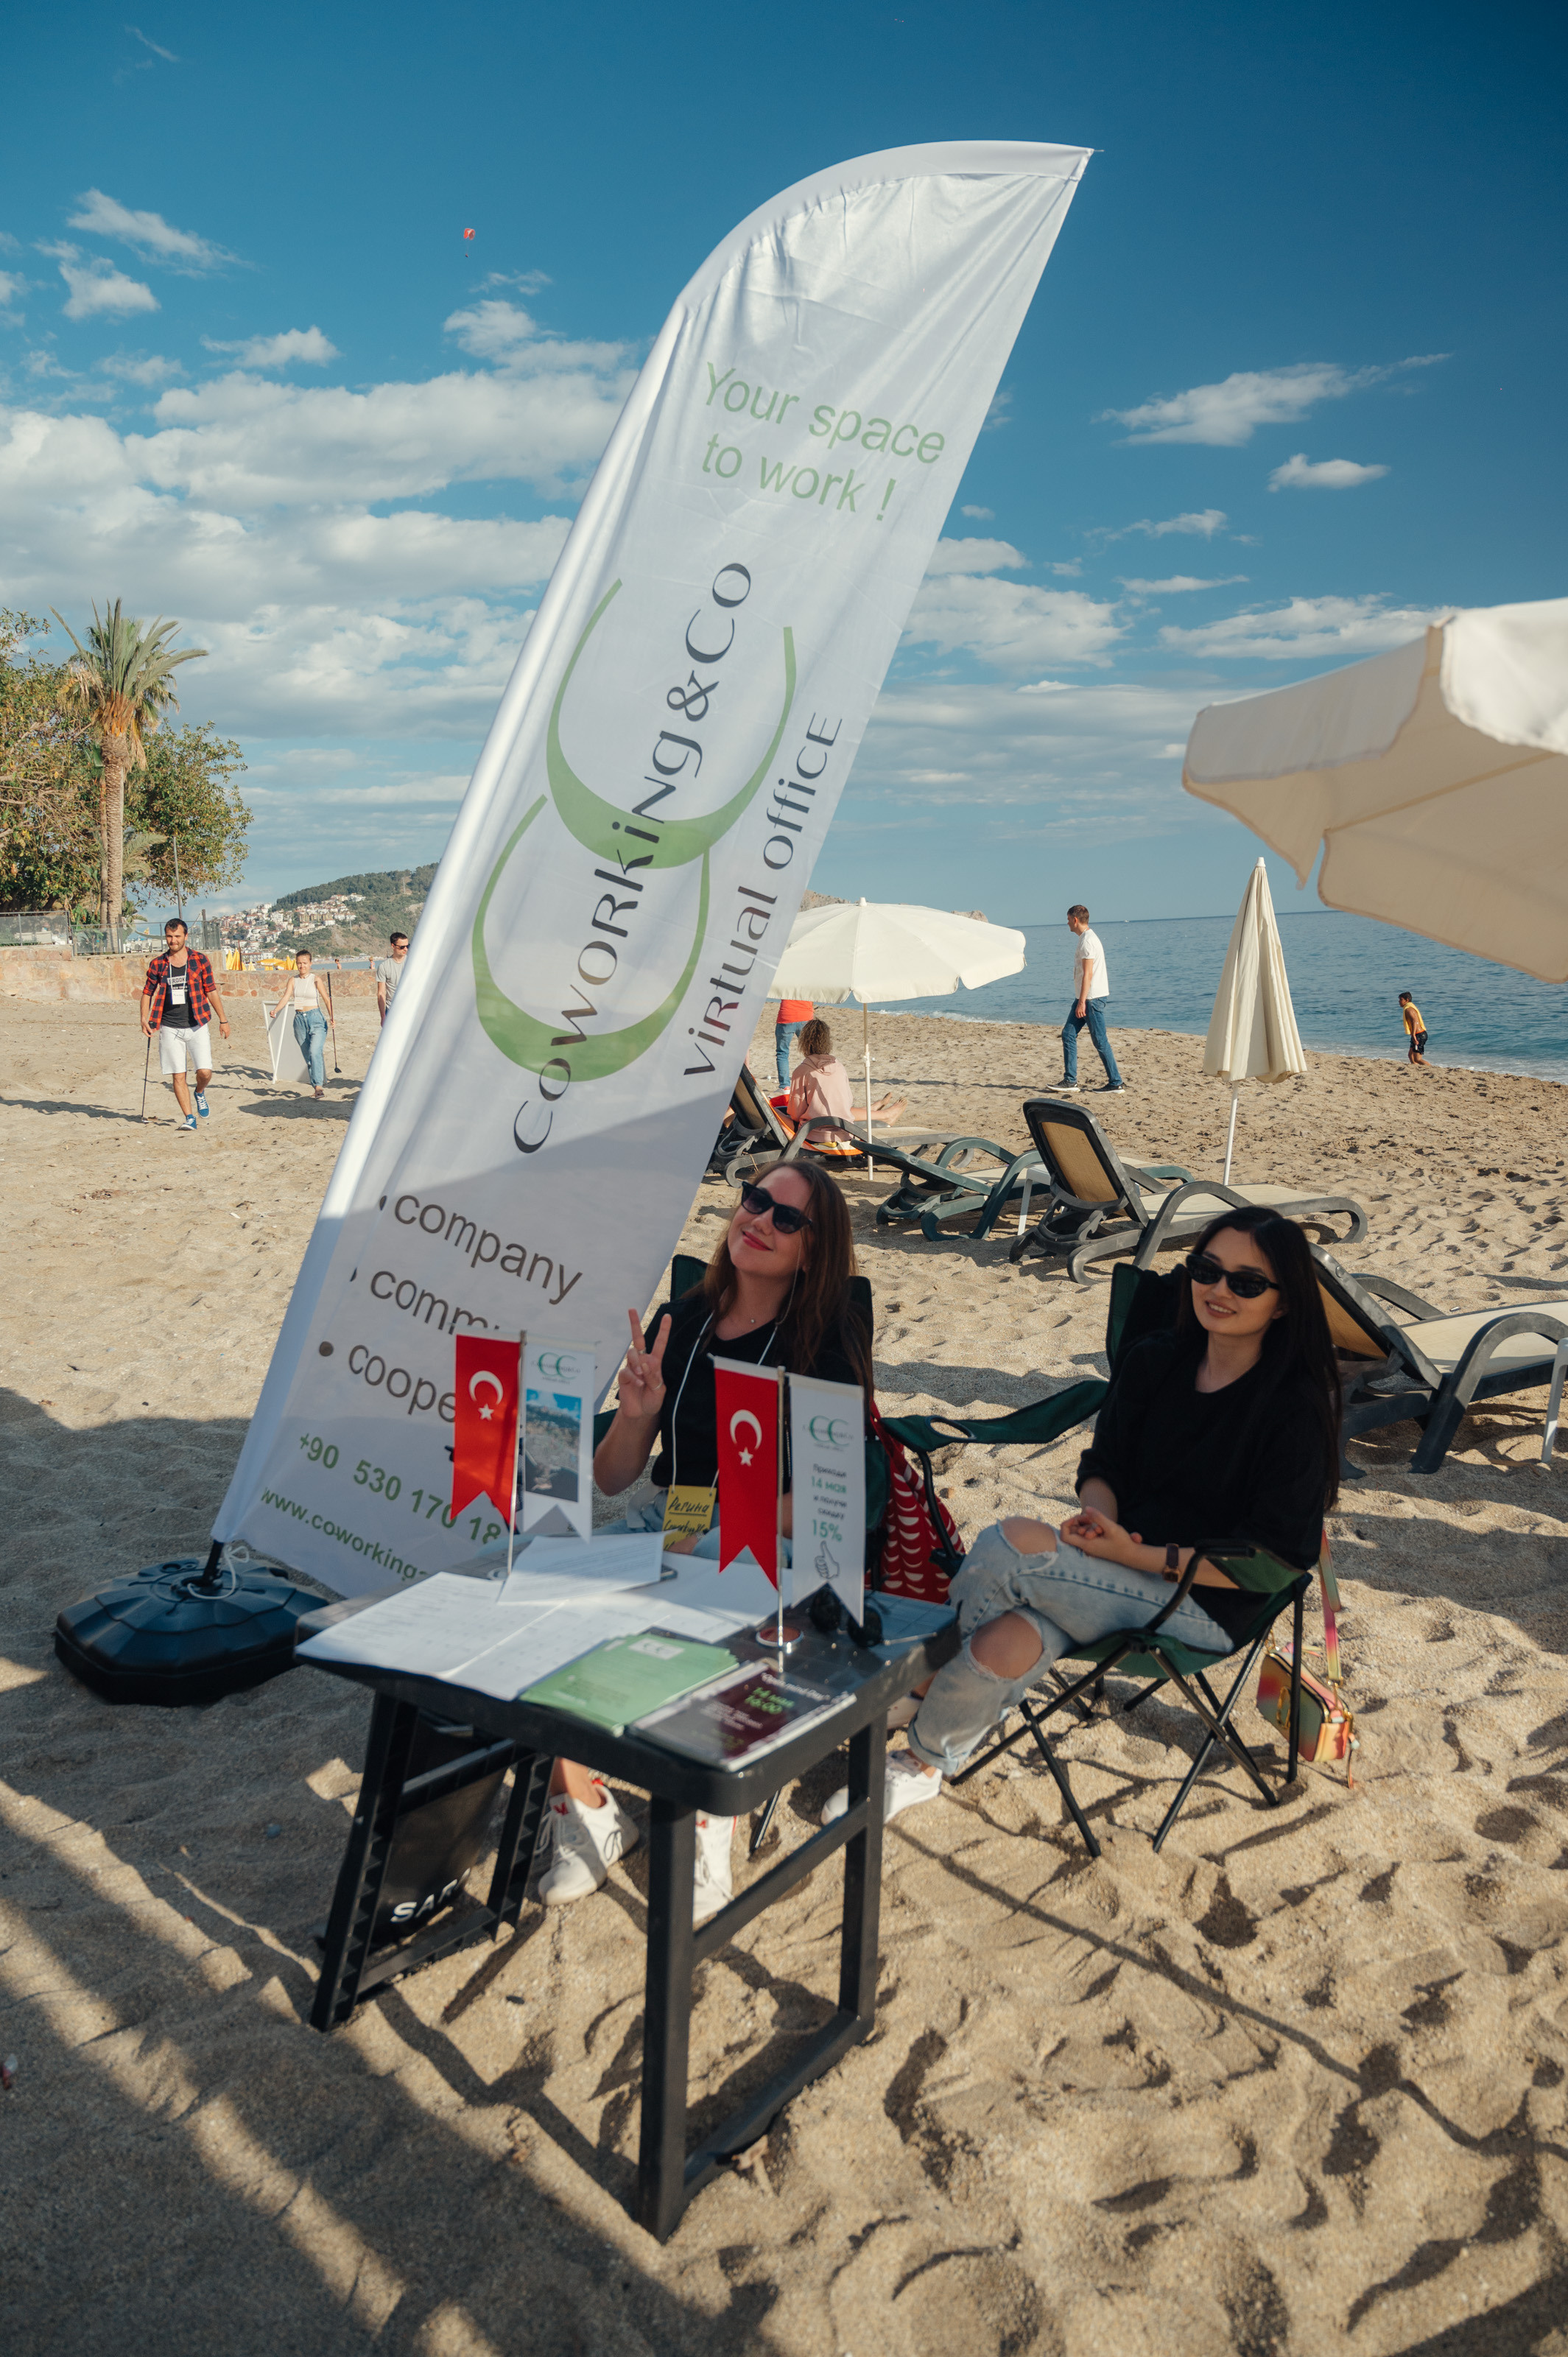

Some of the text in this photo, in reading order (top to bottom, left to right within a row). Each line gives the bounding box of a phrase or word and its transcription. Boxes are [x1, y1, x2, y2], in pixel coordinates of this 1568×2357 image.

[706, 361, 945, 463] Your space
[702, 433, 742, 478] to
[760, 456, 865, 513] work
[394, 1195, 583, 1305] company
[370, 1271, 501, 1335] comm
[348, 1345, 456, 1422] coope
[299, 1433, 340, 1469] +90
[354, 1459, 401, 1500] 530
[411, 1489, 458, 1528] 170
[812, 1519, 843, 1542] 15%
